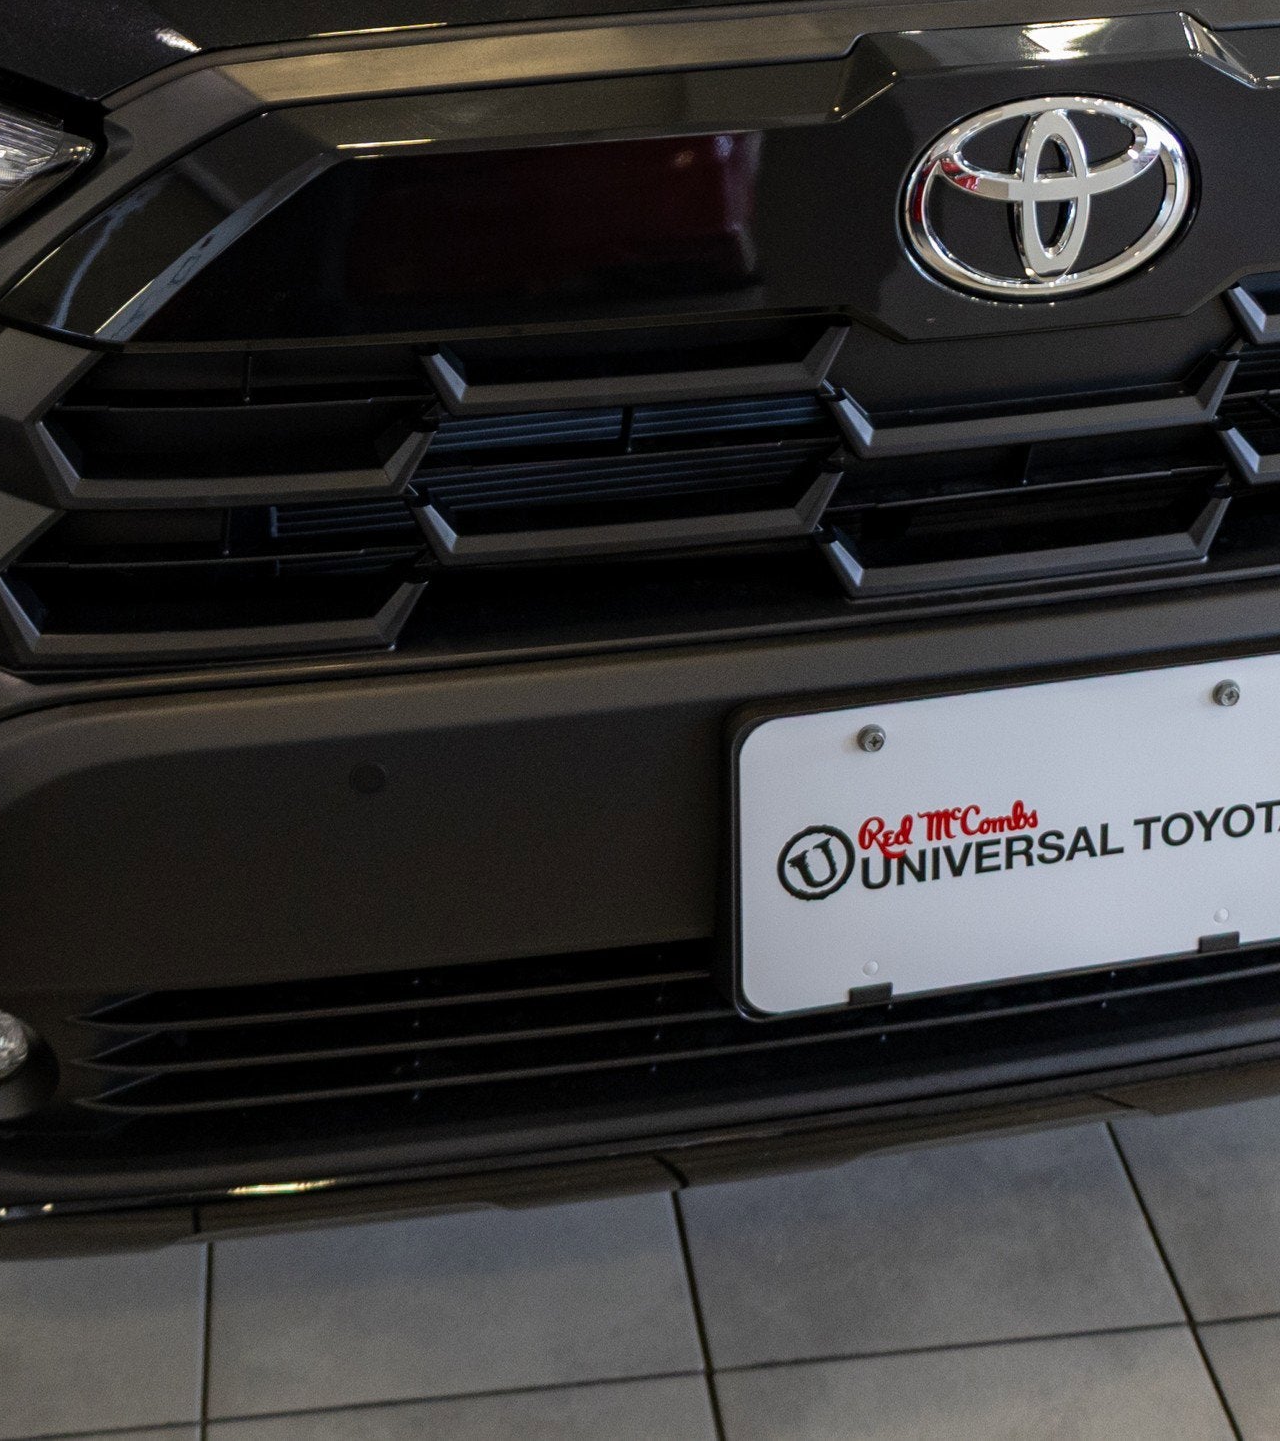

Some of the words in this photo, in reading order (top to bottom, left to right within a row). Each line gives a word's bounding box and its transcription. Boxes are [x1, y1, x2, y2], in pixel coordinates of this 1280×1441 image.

[858, 814, 913, 859] Red
[917, 800, 1038, 842] McCombs
[861, 822, 1125, 889] UNIVERSAL
